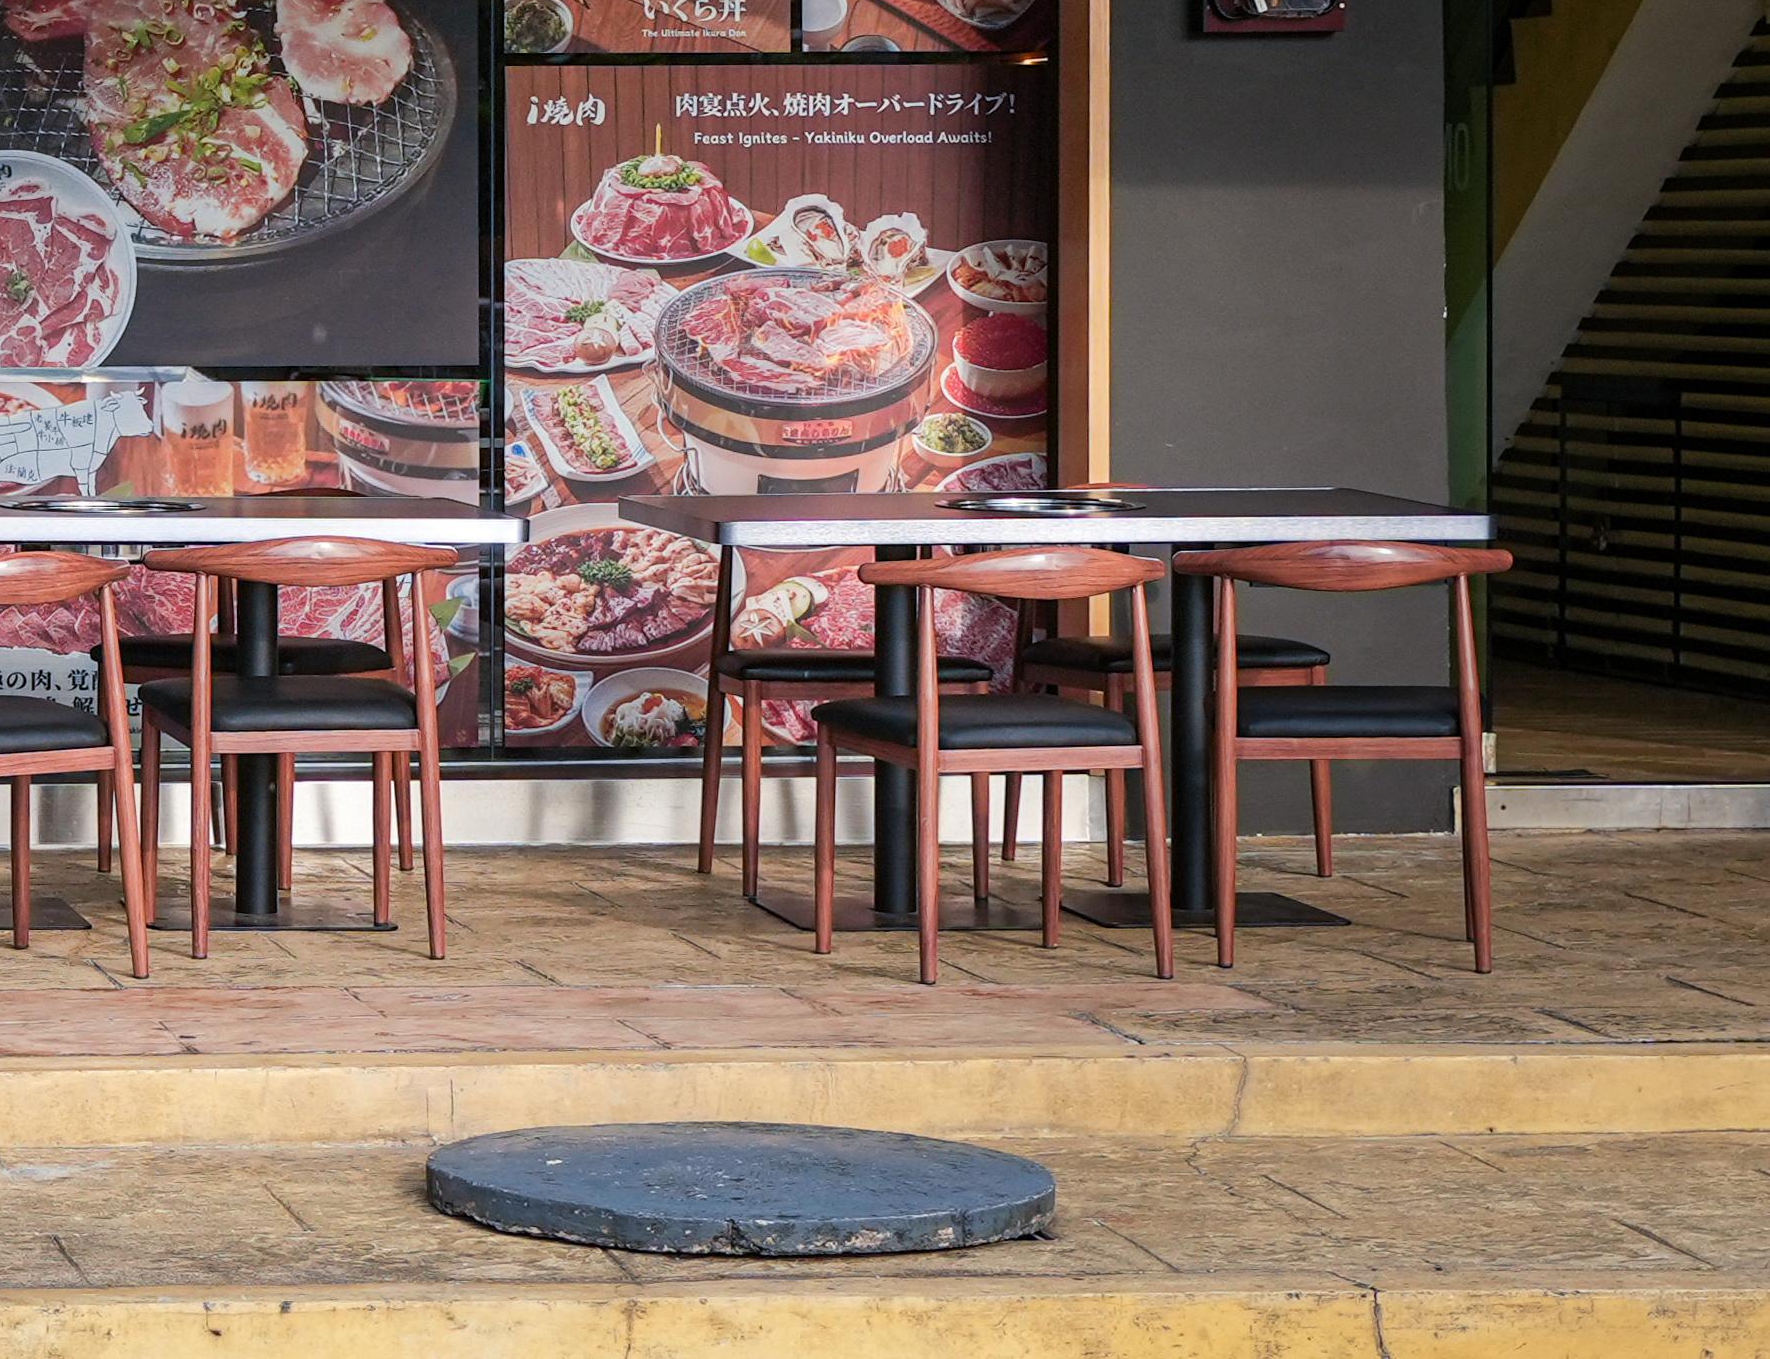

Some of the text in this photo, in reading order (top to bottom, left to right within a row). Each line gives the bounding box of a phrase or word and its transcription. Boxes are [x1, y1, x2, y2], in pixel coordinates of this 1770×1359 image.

[661, 29, 699, 37] Ultimate
[694, 132, 734, 146] Feast
[738, 132, 788, 147] Ignites
[804, 132, 865, 146] Yakiniku
[869, 132, 933, 146] Overload
[938, 132, 993, 146] Awaits!
